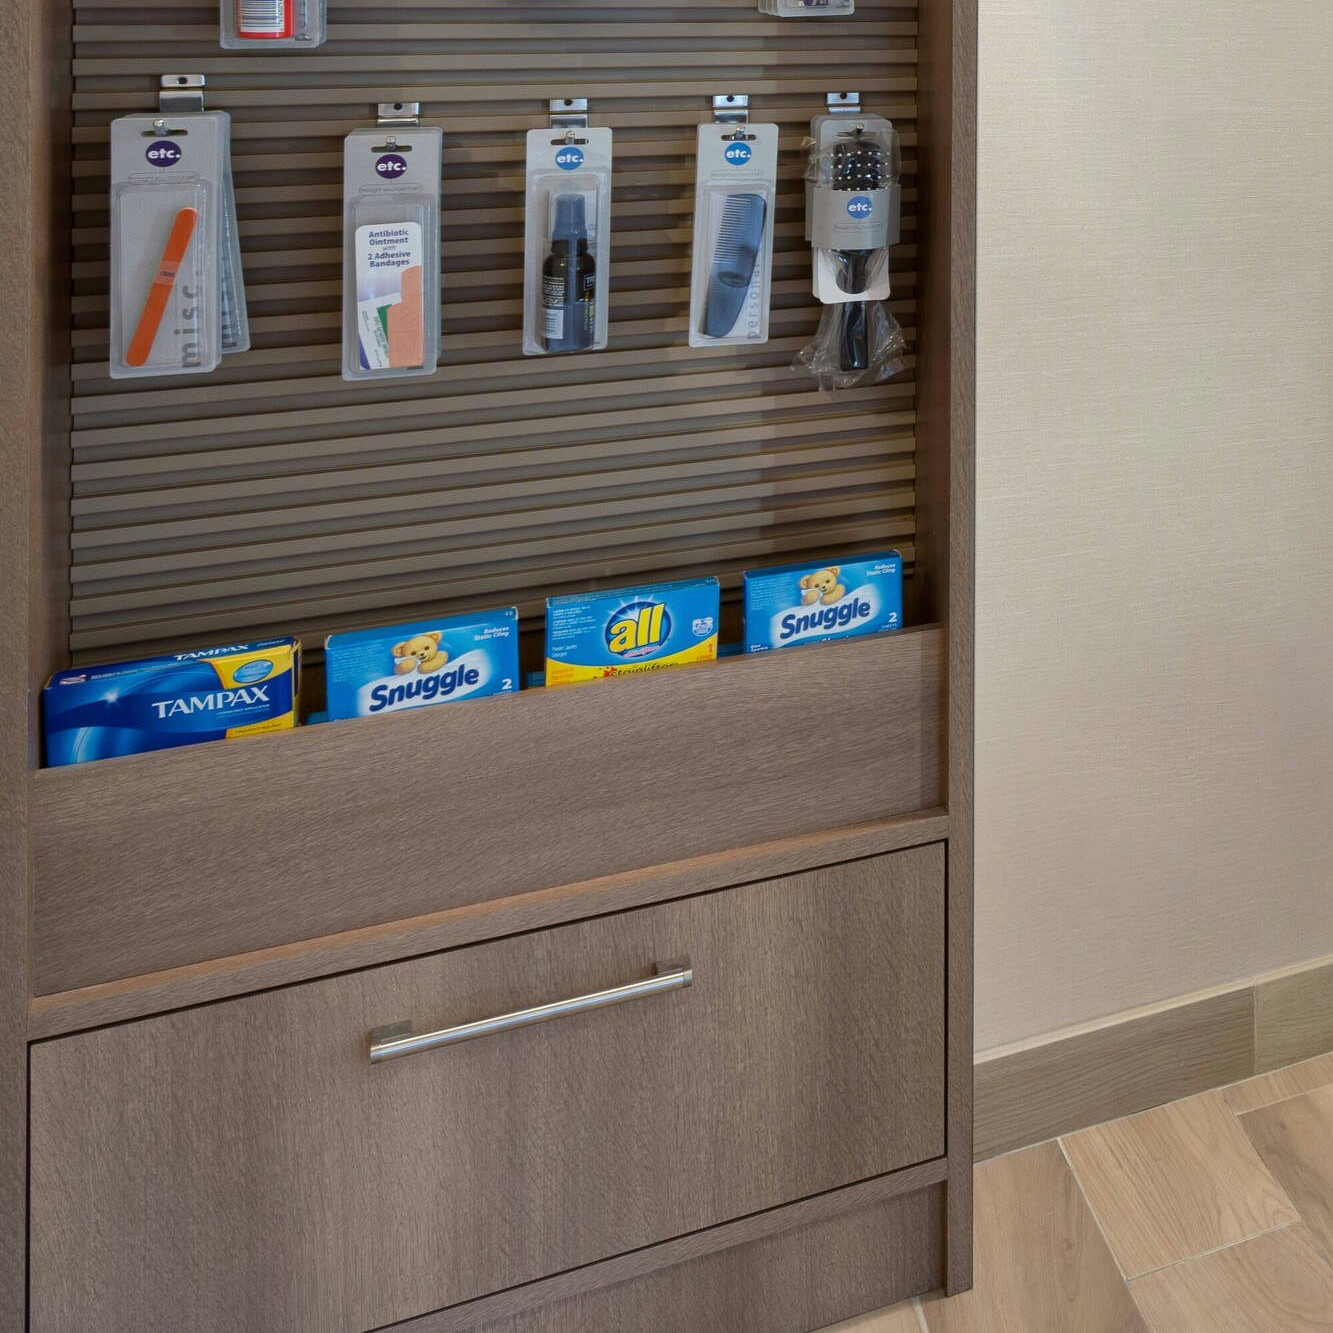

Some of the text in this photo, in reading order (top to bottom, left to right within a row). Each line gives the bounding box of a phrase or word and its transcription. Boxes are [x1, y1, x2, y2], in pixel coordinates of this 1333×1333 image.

[147, 148, 182, 160] etc.
[556, 154, 584, 164] etc.
[847, 202, 873, 213] etc.
[368, 229, 409, 239] Antibiotic
[369, 237, 409, 246] Ointment
[374, 251, 412, 260] Adhesive
[369, 259, 410, 269] Bandages
[779, 596, 871, 641] Snuggle
[888, 611, 897, 624] 2
[608, 603, 666, 653] all
[174, 643, 249, 662] TAMPAX
[368, 665, 480, 712] Snuggle
[501, 678, 513, 692] 2
[151, 684, 270, 719] TAMPAX
